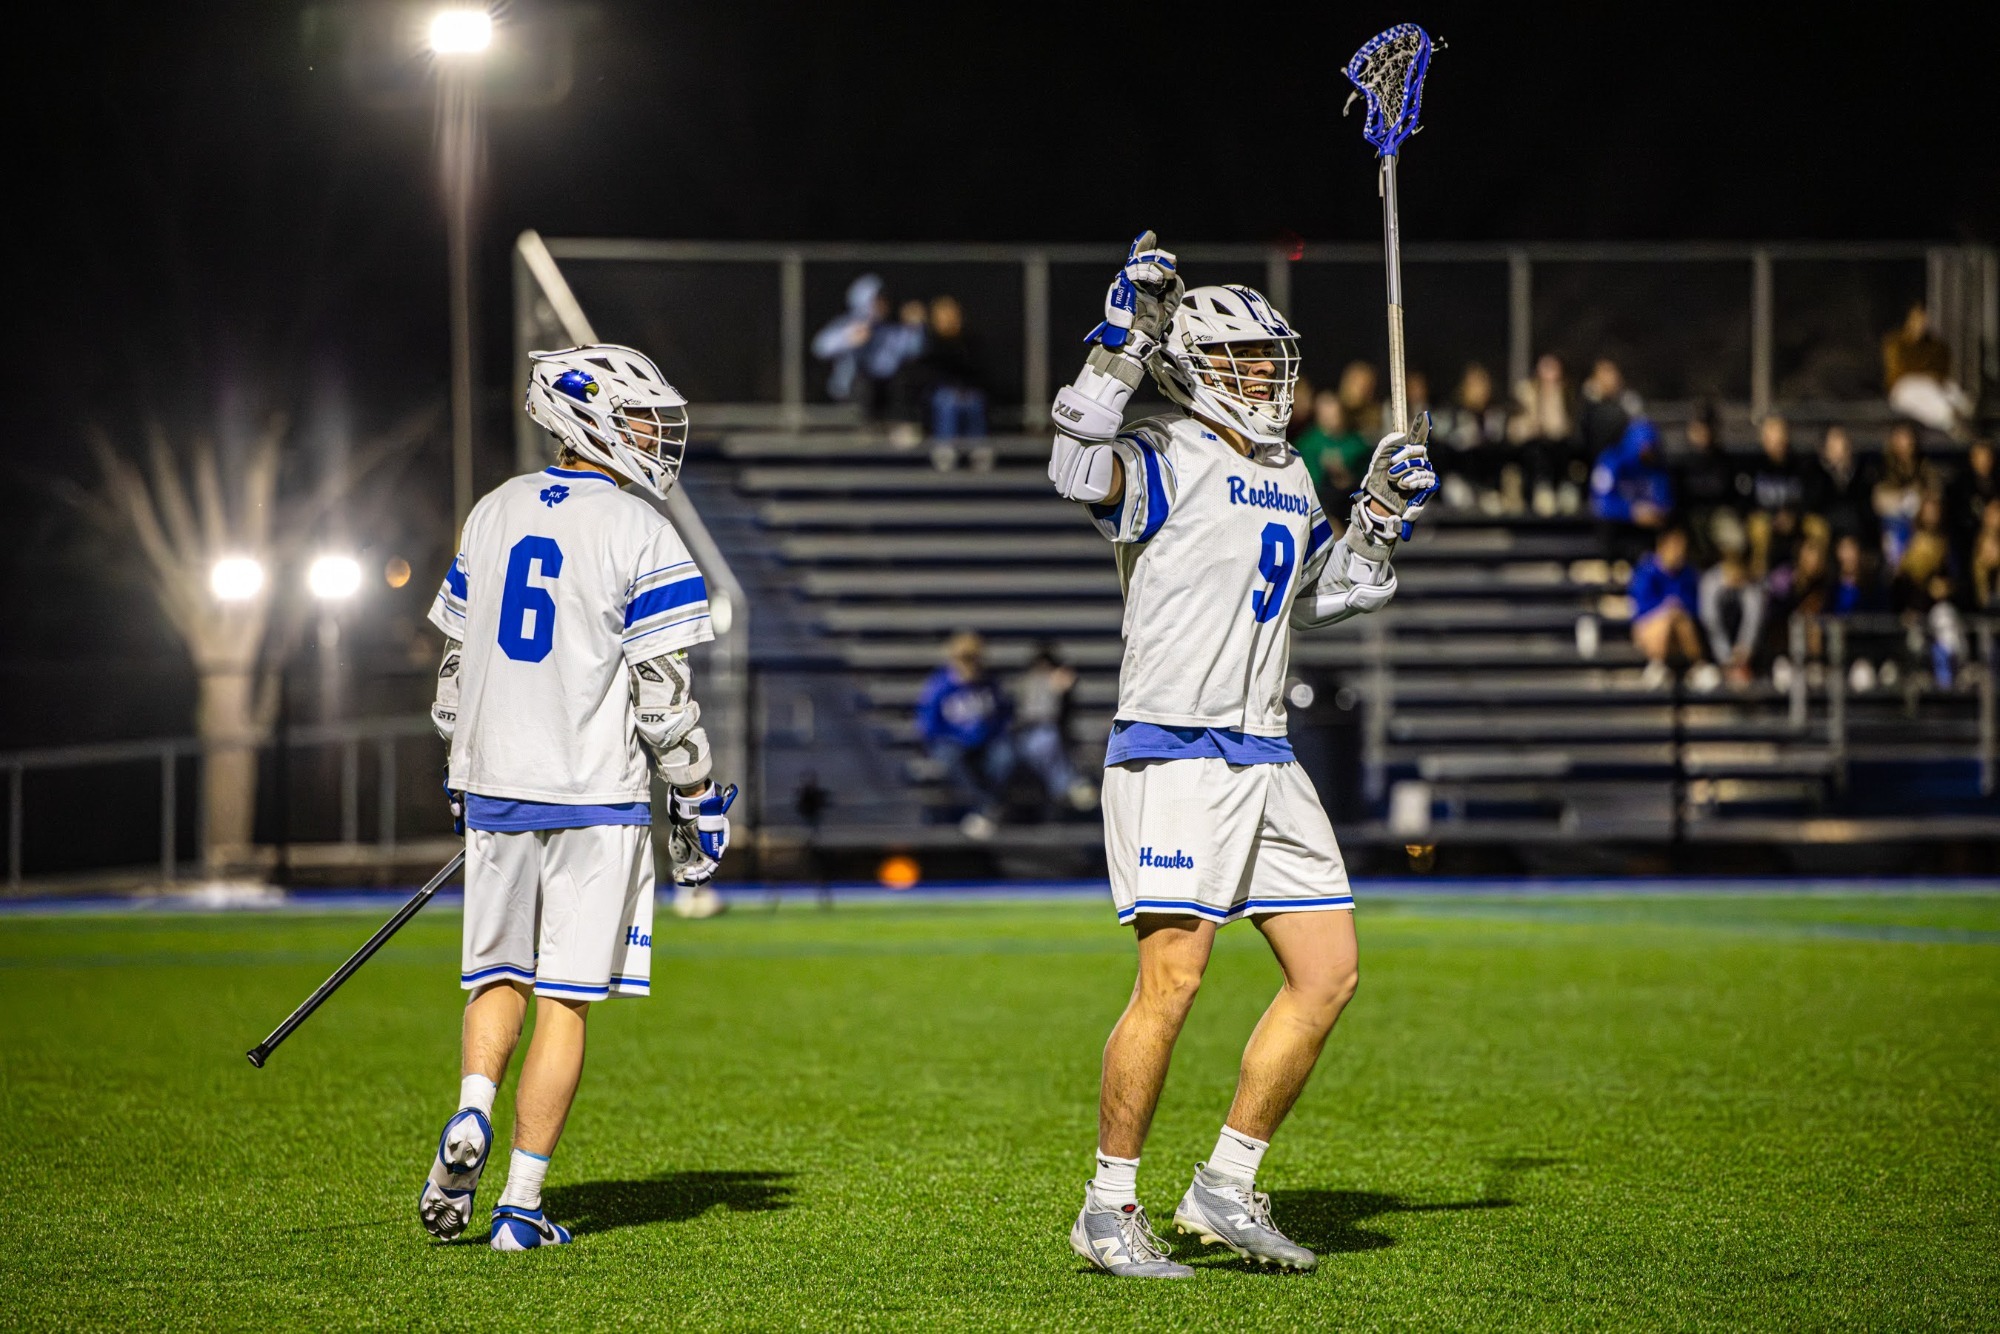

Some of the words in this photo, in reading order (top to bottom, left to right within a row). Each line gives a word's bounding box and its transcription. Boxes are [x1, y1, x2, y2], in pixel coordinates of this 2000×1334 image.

[1115, 286, 1125, 305] TRUST
[1054, 400, 1085, 423] STX
[548, 491, 563, 499] KK
[1251, 522, 1296, 624] 9
[497, 534, 564, 663] 6
[641, 713, 666, 723] STX
[1139, 846, 1194, 870] Hawks
